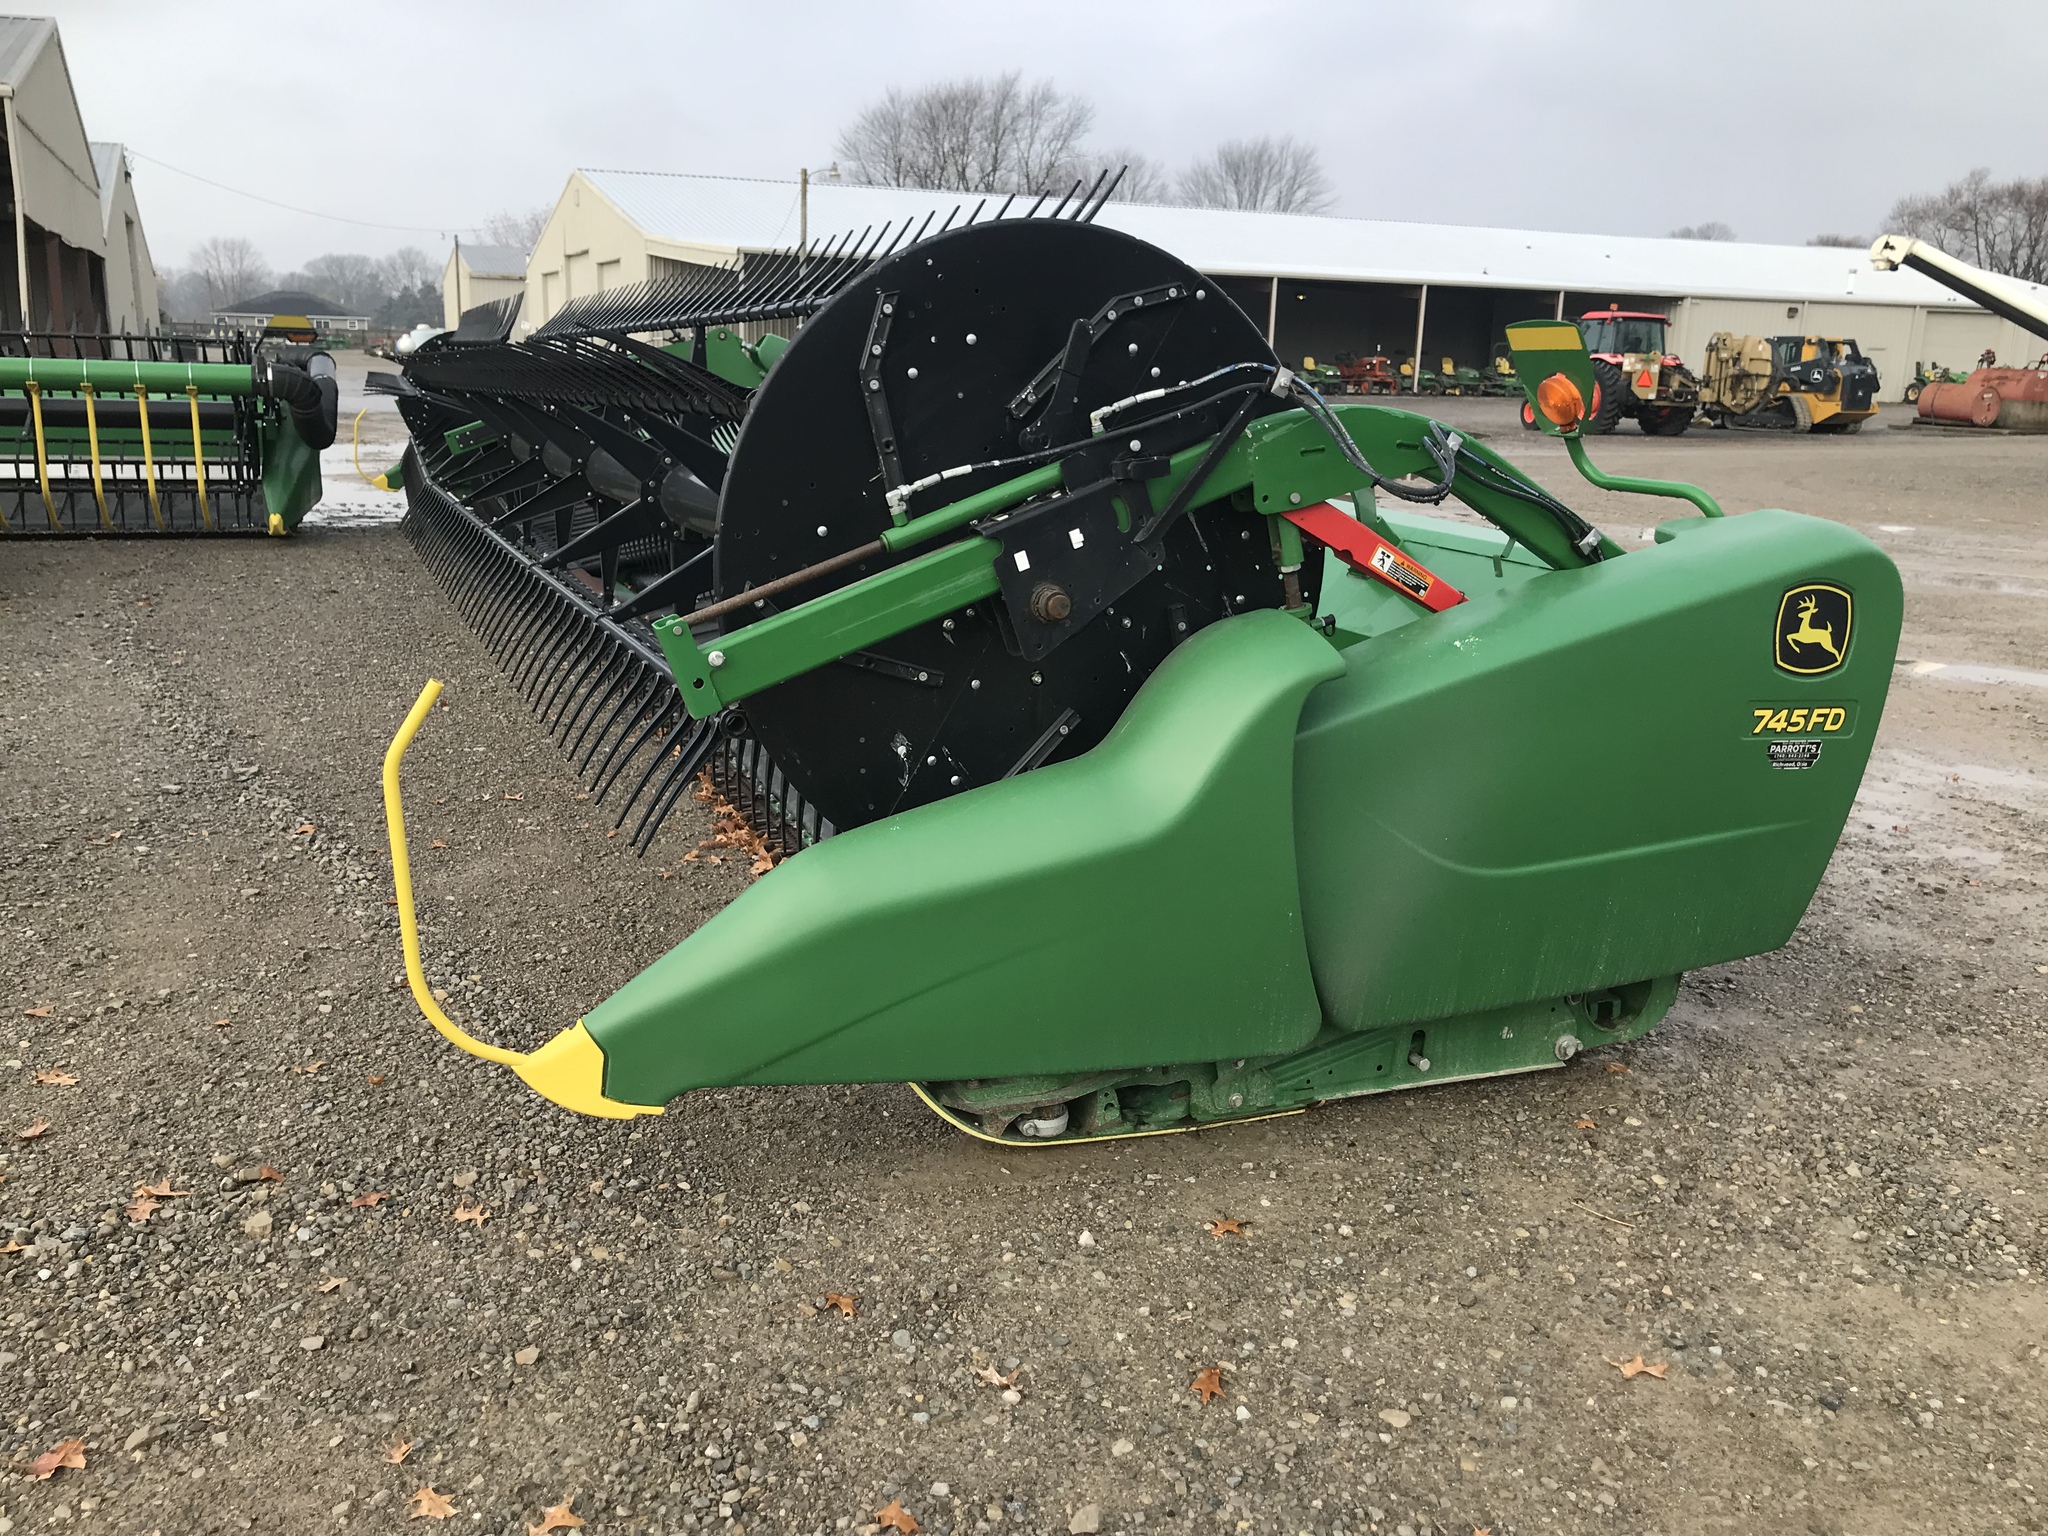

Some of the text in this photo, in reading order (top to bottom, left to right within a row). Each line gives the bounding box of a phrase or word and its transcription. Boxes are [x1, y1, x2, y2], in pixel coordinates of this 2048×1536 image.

[1407, 564, 1427, 580] WARNING
[1752, 707, 1846, 733] 745FD
[1770, 744, 1817, 753] PARROTT'S
